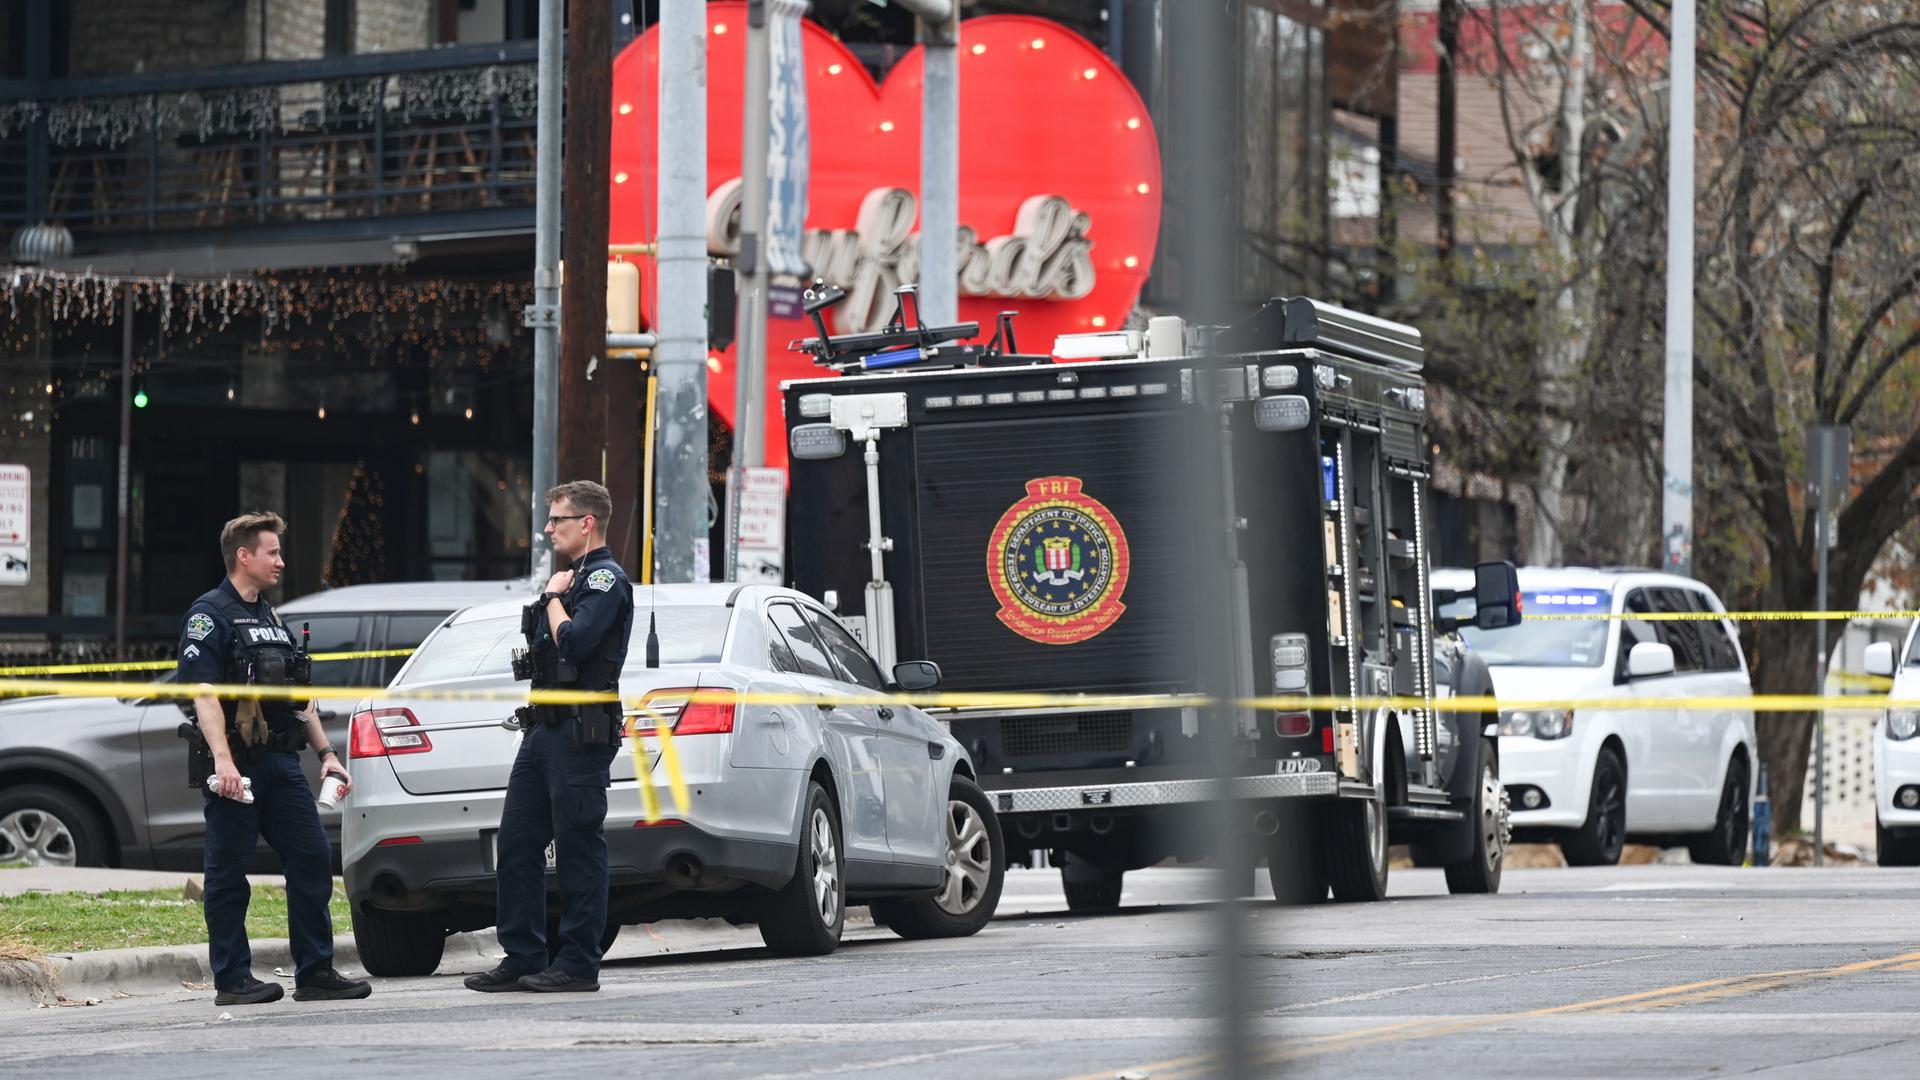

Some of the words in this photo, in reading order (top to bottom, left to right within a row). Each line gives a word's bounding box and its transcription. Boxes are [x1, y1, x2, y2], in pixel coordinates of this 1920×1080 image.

[1039, 481, 1070, 496] FBI
[1010, 511, 1060, 548] DEPARTMENT
[1075, 514, 1104, 545] JUSTICE
[1008, 553, 1025, 596] FEDERAL
[1024, 594, 1058, 612] BUREAU
[1060, 605, 1073, 613] OF
[1074, 548, 1110, 610] INVESTIGATION
[1047, 625, 1095, 641] Response
[1093, 605, 1118, 626] Team
[1277, 759, 1307, 774] LDV
